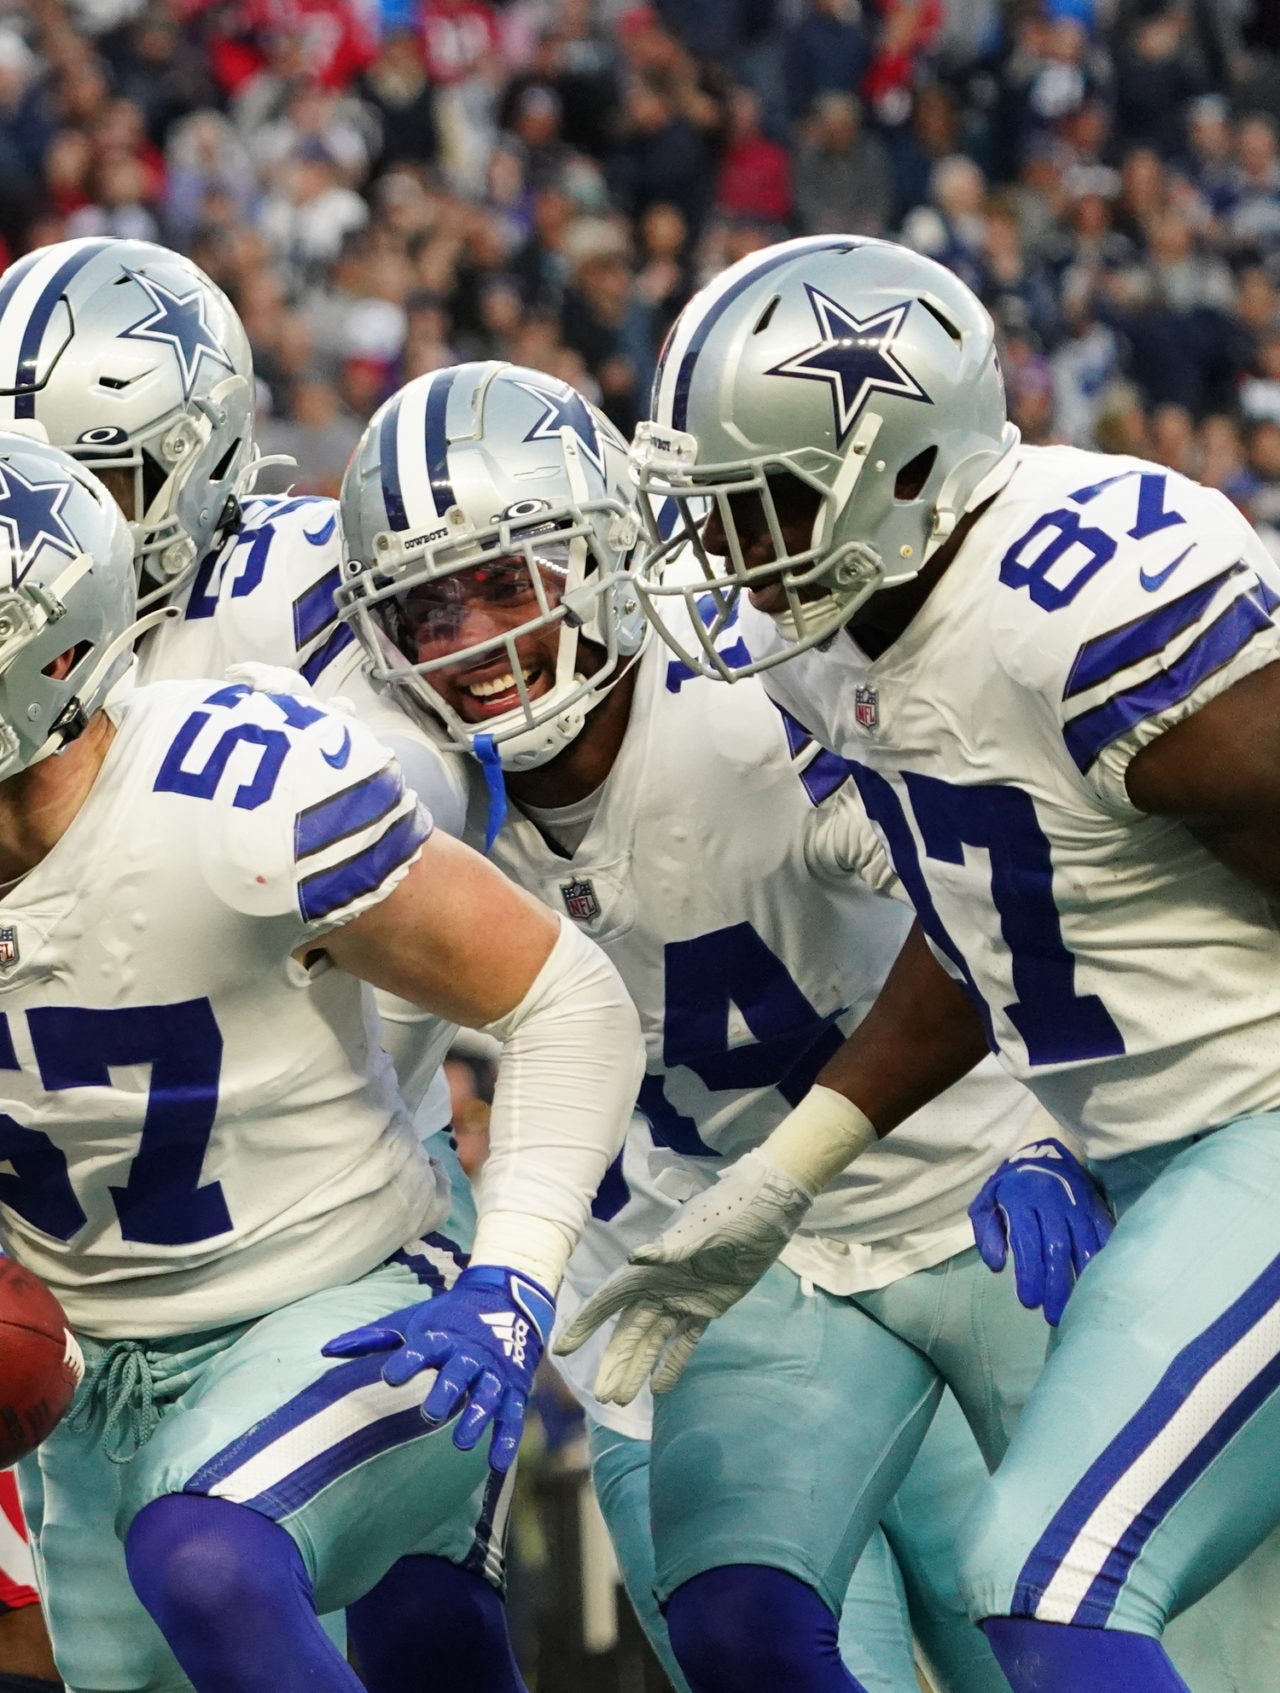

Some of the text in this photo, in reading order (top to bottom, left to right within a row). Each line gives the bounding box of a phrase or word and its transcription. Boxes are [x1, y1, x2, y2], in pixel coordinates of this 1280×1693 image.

[404, 527, 449, 549] COWBOYS
[999, 471, 1187, 613] 87
[569, 897, 595, 916] NFL
[846, 758, 1126, 1066] 7
